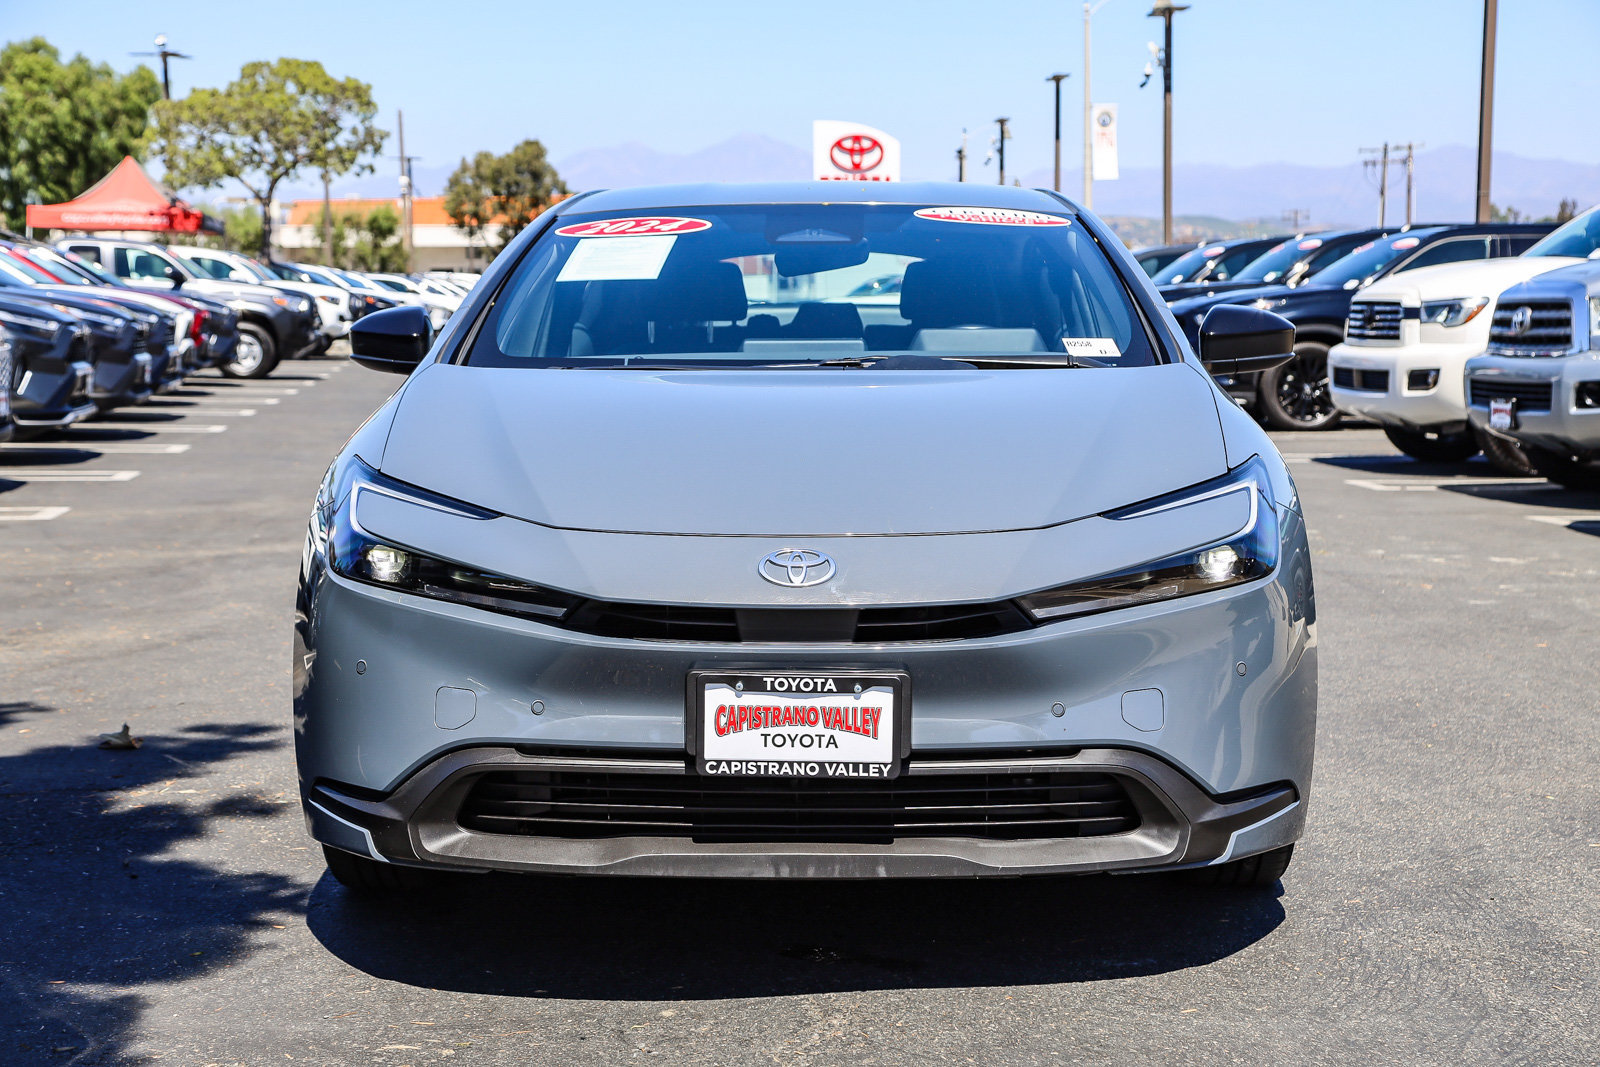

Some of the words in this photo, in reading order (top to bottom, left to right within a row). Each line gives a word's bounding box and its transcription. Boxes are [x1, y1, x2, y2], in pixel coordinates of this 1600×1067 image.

[574, 218, 689, 235] 2024
[763, 677, 838, 692] TOYOTA
[714, 704, 820, 737] CAPISTRANO
[820, 706, 882, 740] VALLEY
[760, 733, 839, 748] TOYOTA
[705, 761, 820, 776] CAPISTRANO
[824, 762, 892, 777] VALLEY
